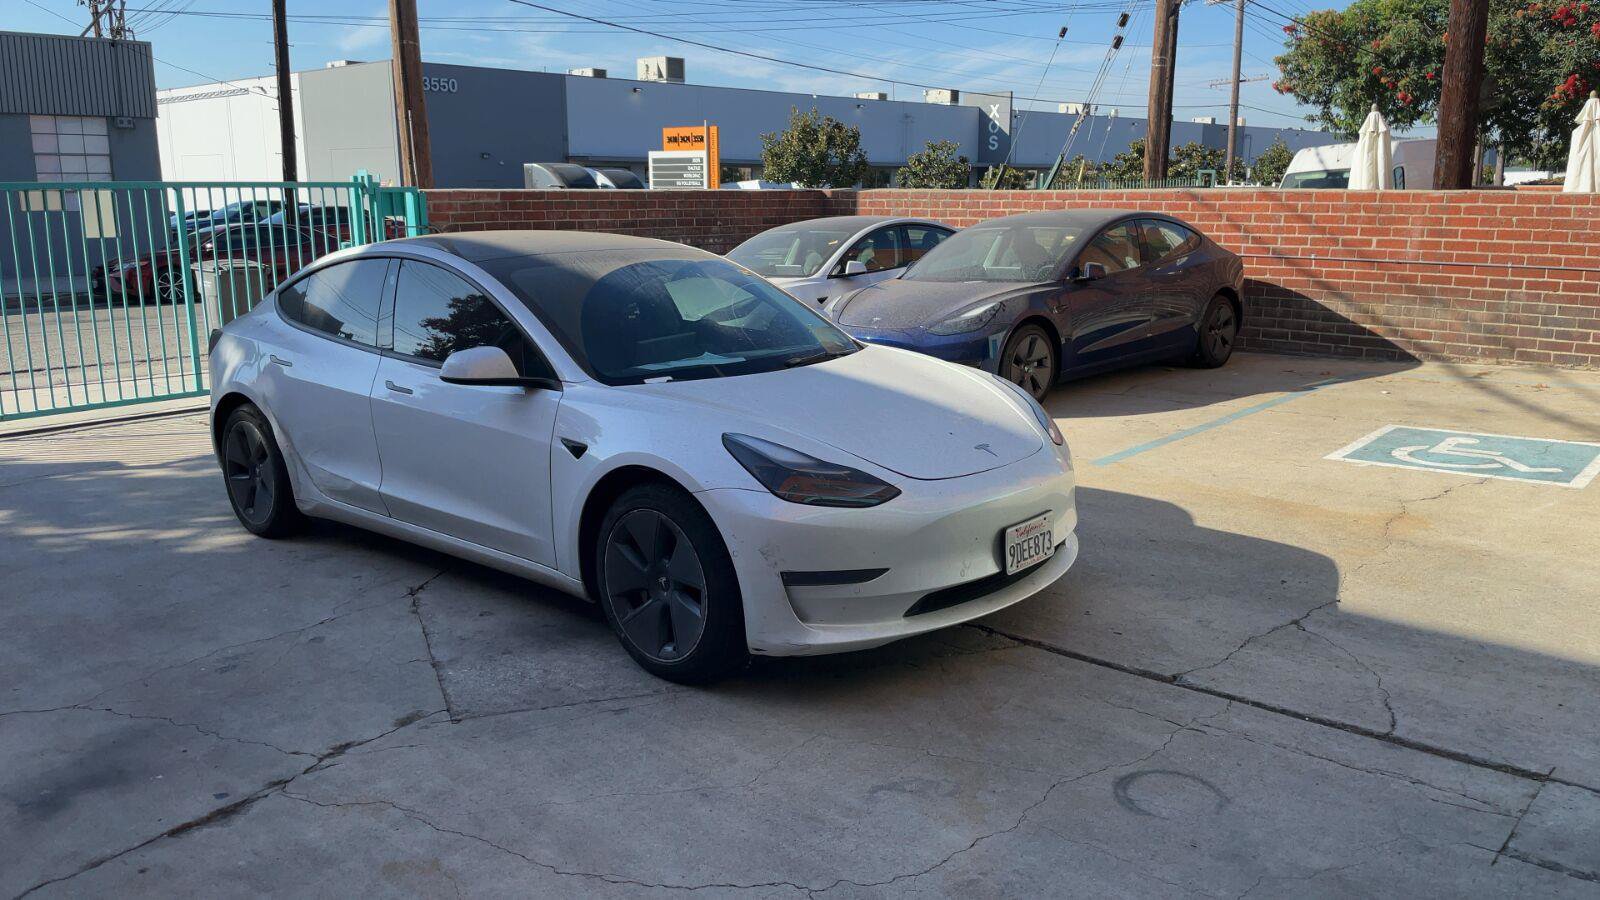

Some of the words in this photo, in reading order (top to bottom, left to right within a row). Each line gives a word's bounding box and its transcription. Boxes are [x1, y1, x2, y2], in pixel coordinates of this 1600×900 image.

[423, 76, 458, 93] 3550
[988, 103, 1000, 151] XOS
[1008, 529, 1052, 569] 9DEE873
